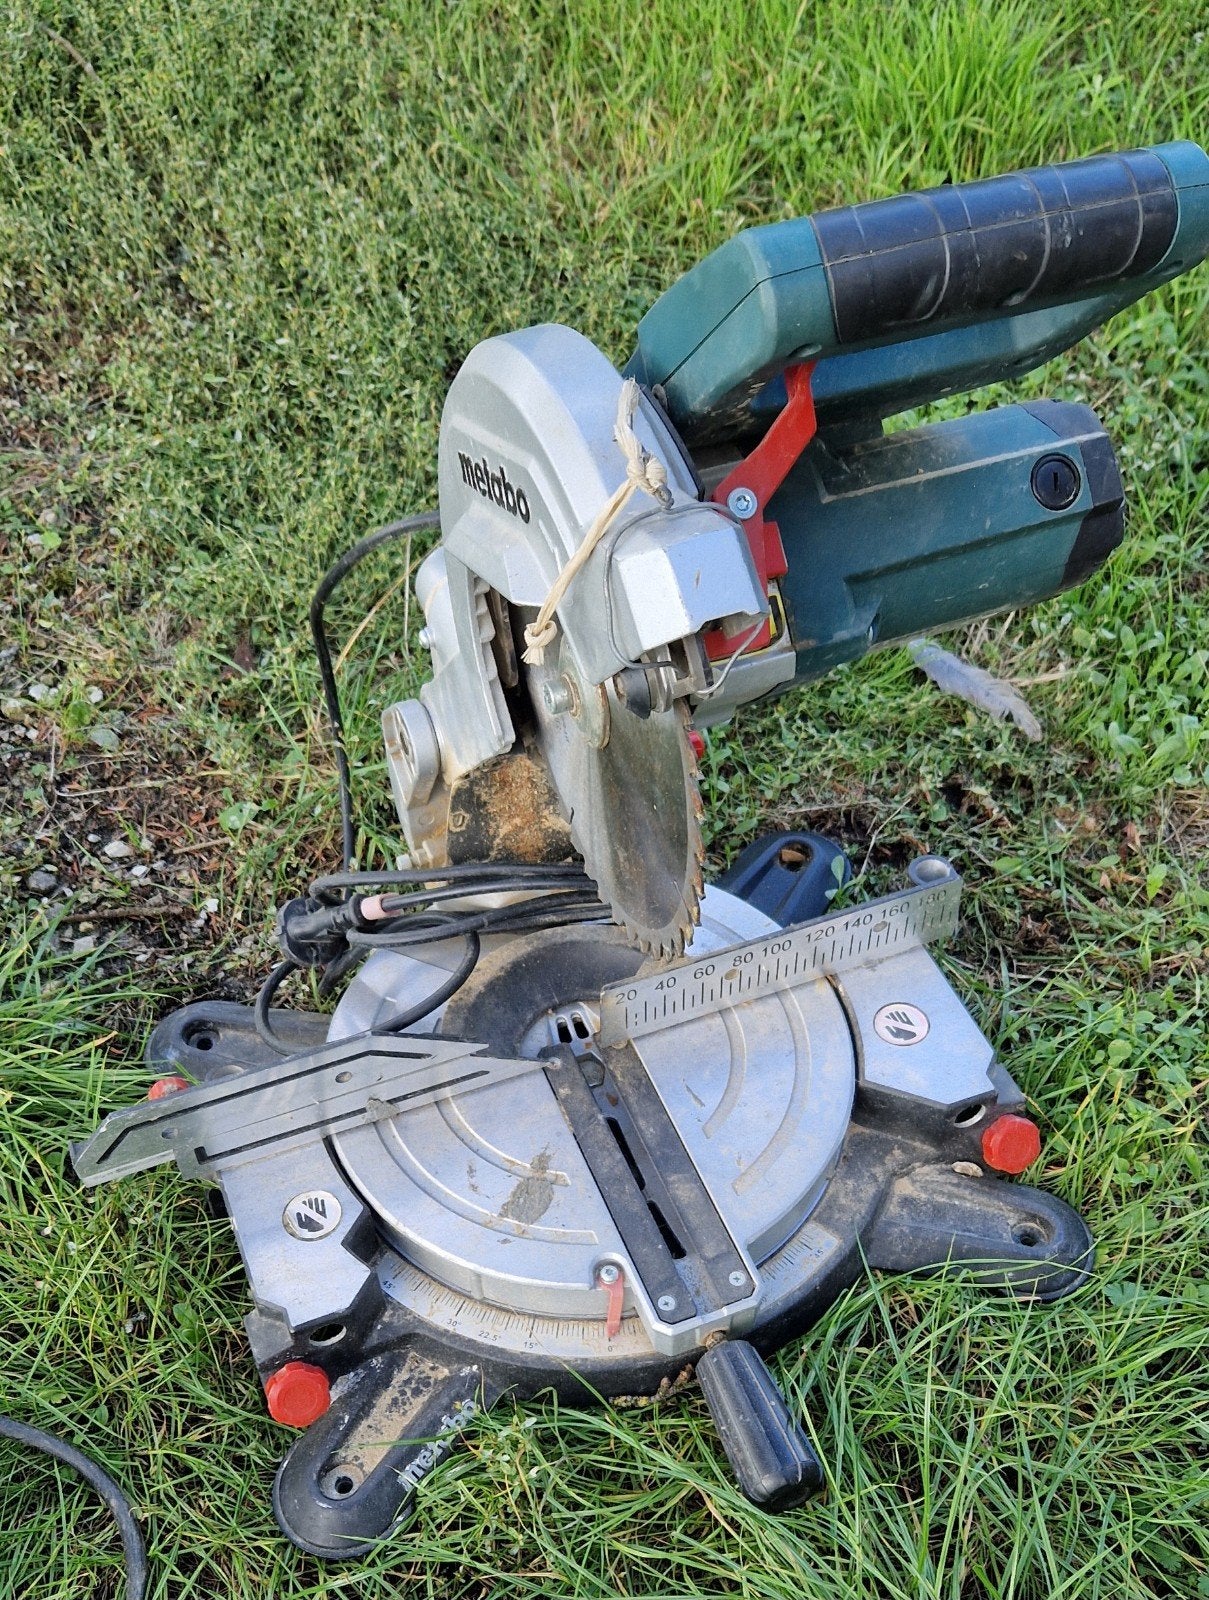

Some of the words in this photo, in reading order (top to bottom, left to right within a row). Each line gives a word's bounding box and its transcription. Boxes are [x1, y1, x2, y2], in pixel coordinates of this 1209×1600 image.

[458, 451, 530, 524] metabo
[615, 989, 637, 1005] 20
[655, 976, 676, 991] 40
[693, 964, 715, 979] 60
[732, 951, 754, 967] 80
[762, 940, 792, 957] 100
[805, 926, 835, 943] 120
[843, 913, 873, 931] 140
[880, 901, 910, 919] 160
[918, 889, 947, 906] 180
